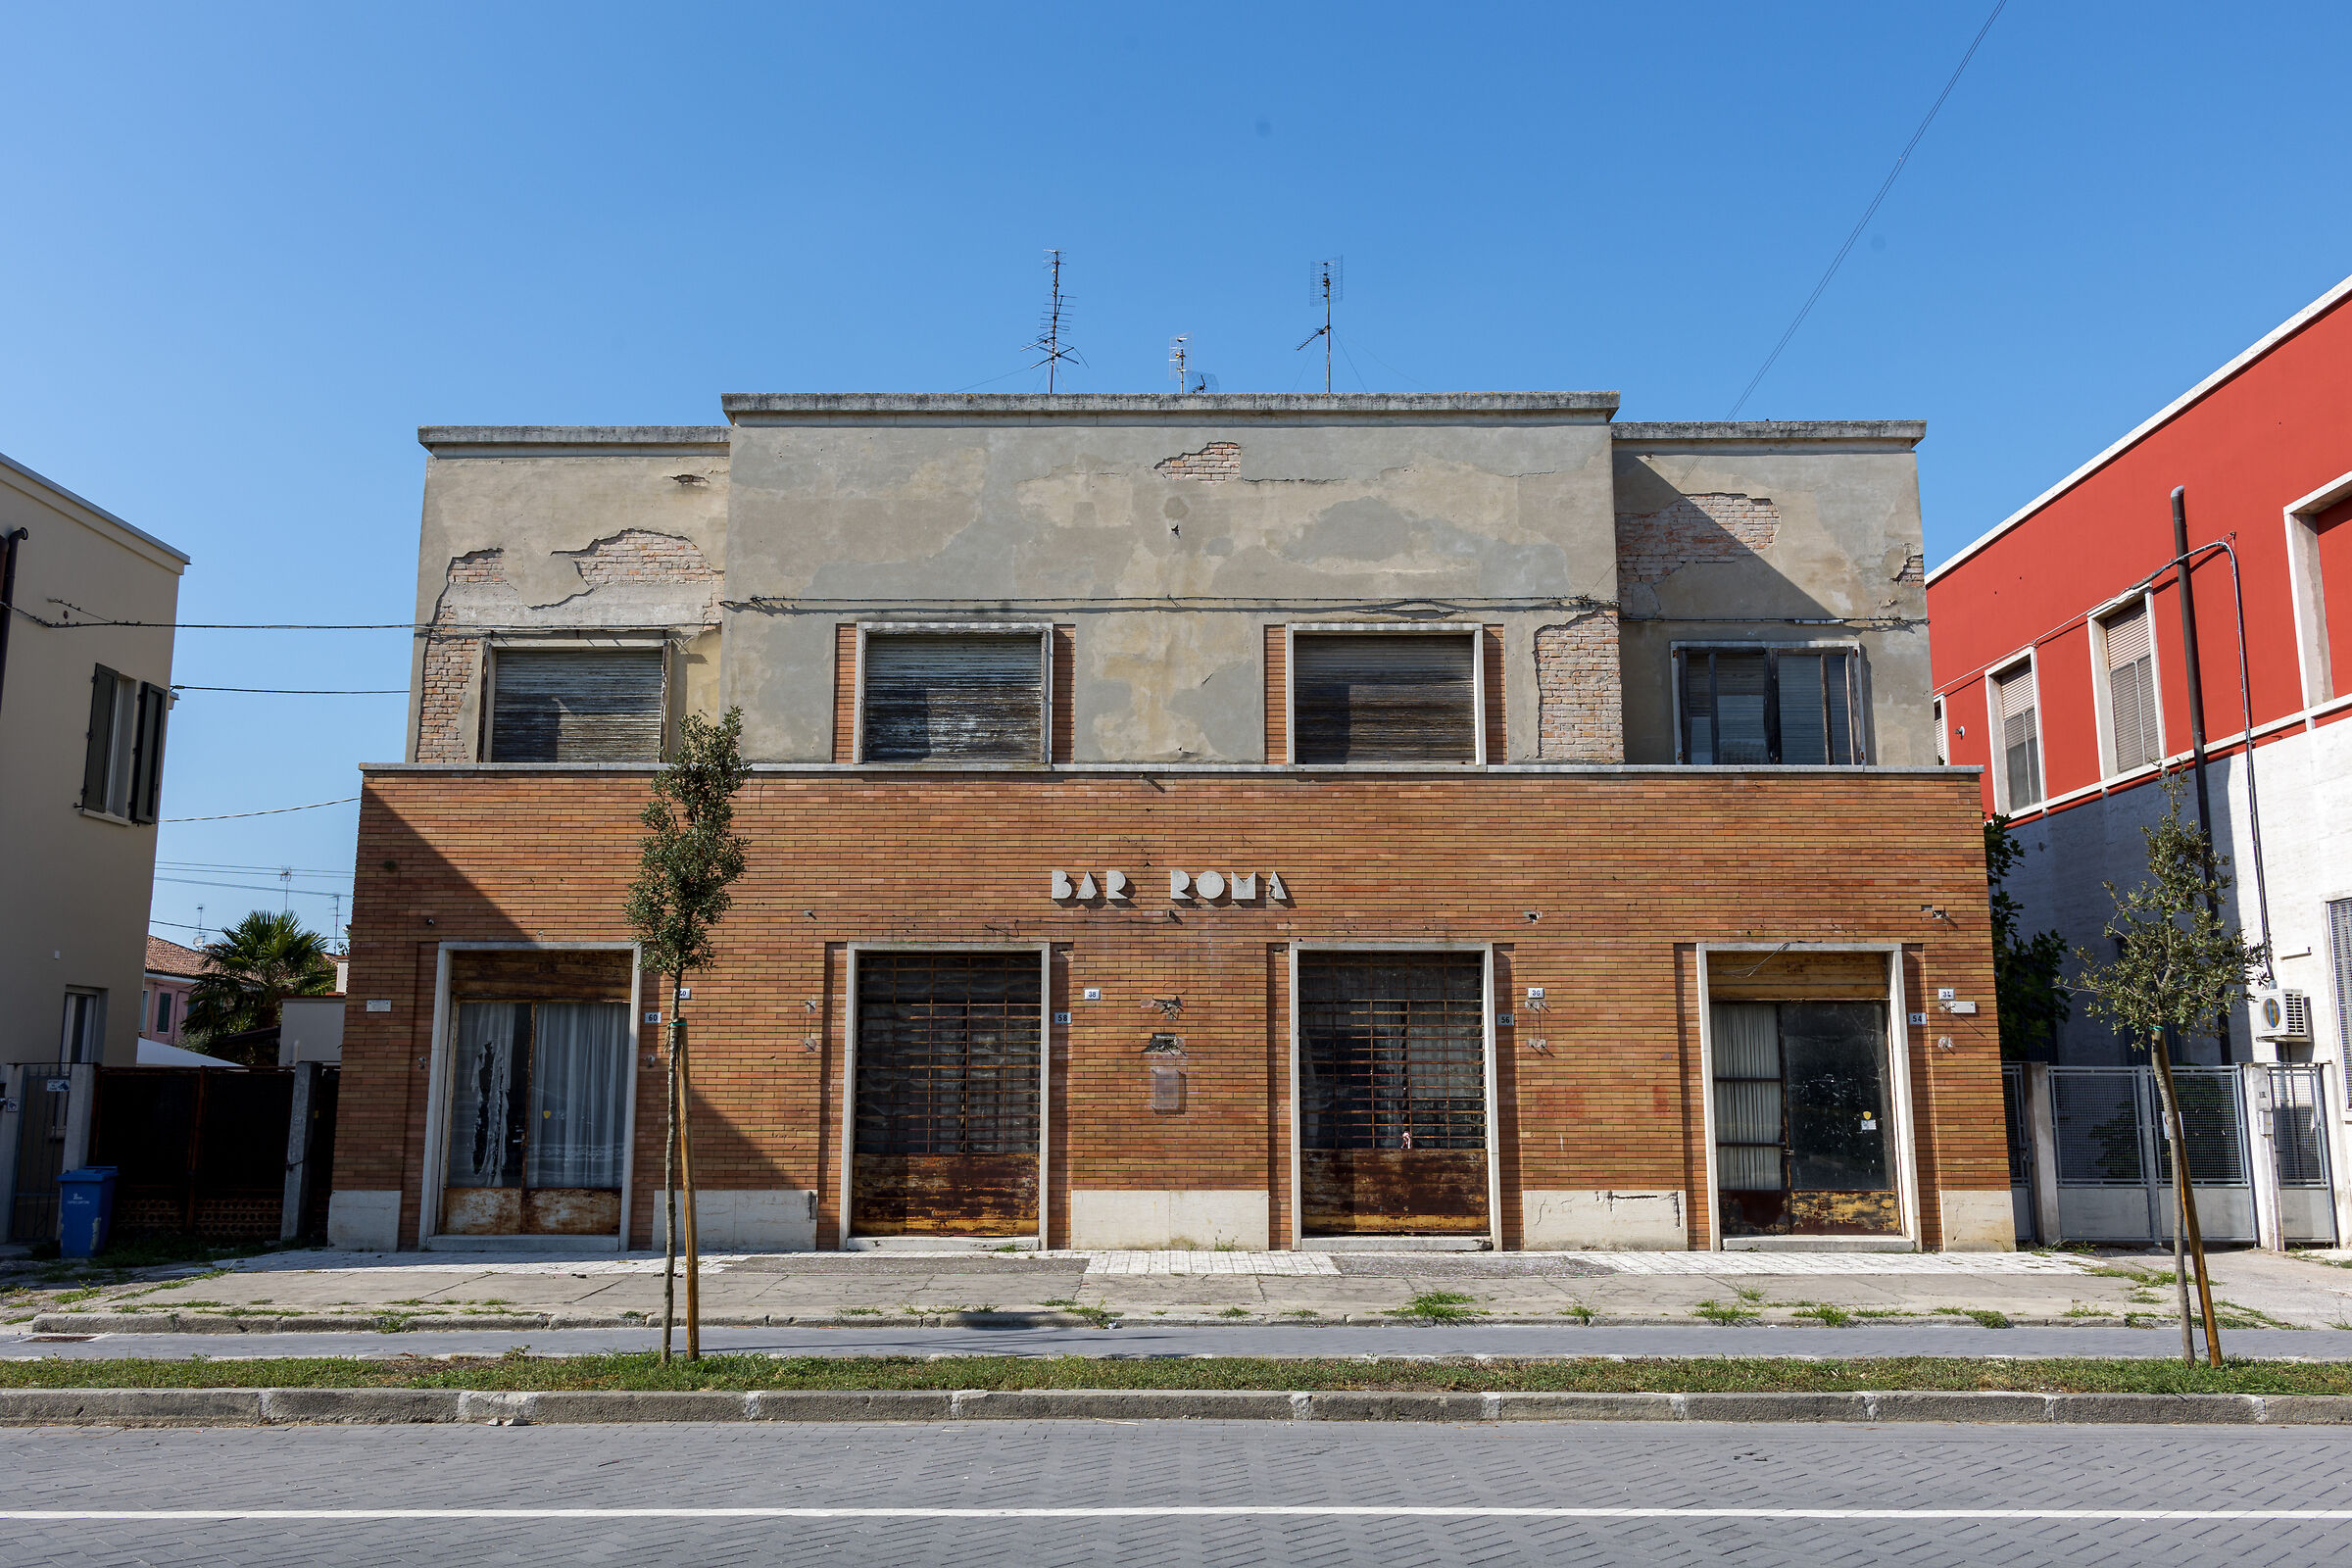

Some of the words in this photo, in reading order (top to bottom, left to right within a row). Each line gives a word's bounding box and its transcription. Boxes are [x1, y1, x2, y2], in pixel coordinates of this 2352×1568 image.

[1052, 870, 1128, 899] BAR
[1170, 870, 1287, 900] ROMA
[1500, 1015, 1510, 1024] 56
[1912, 1014, 1923, 1023] 54
